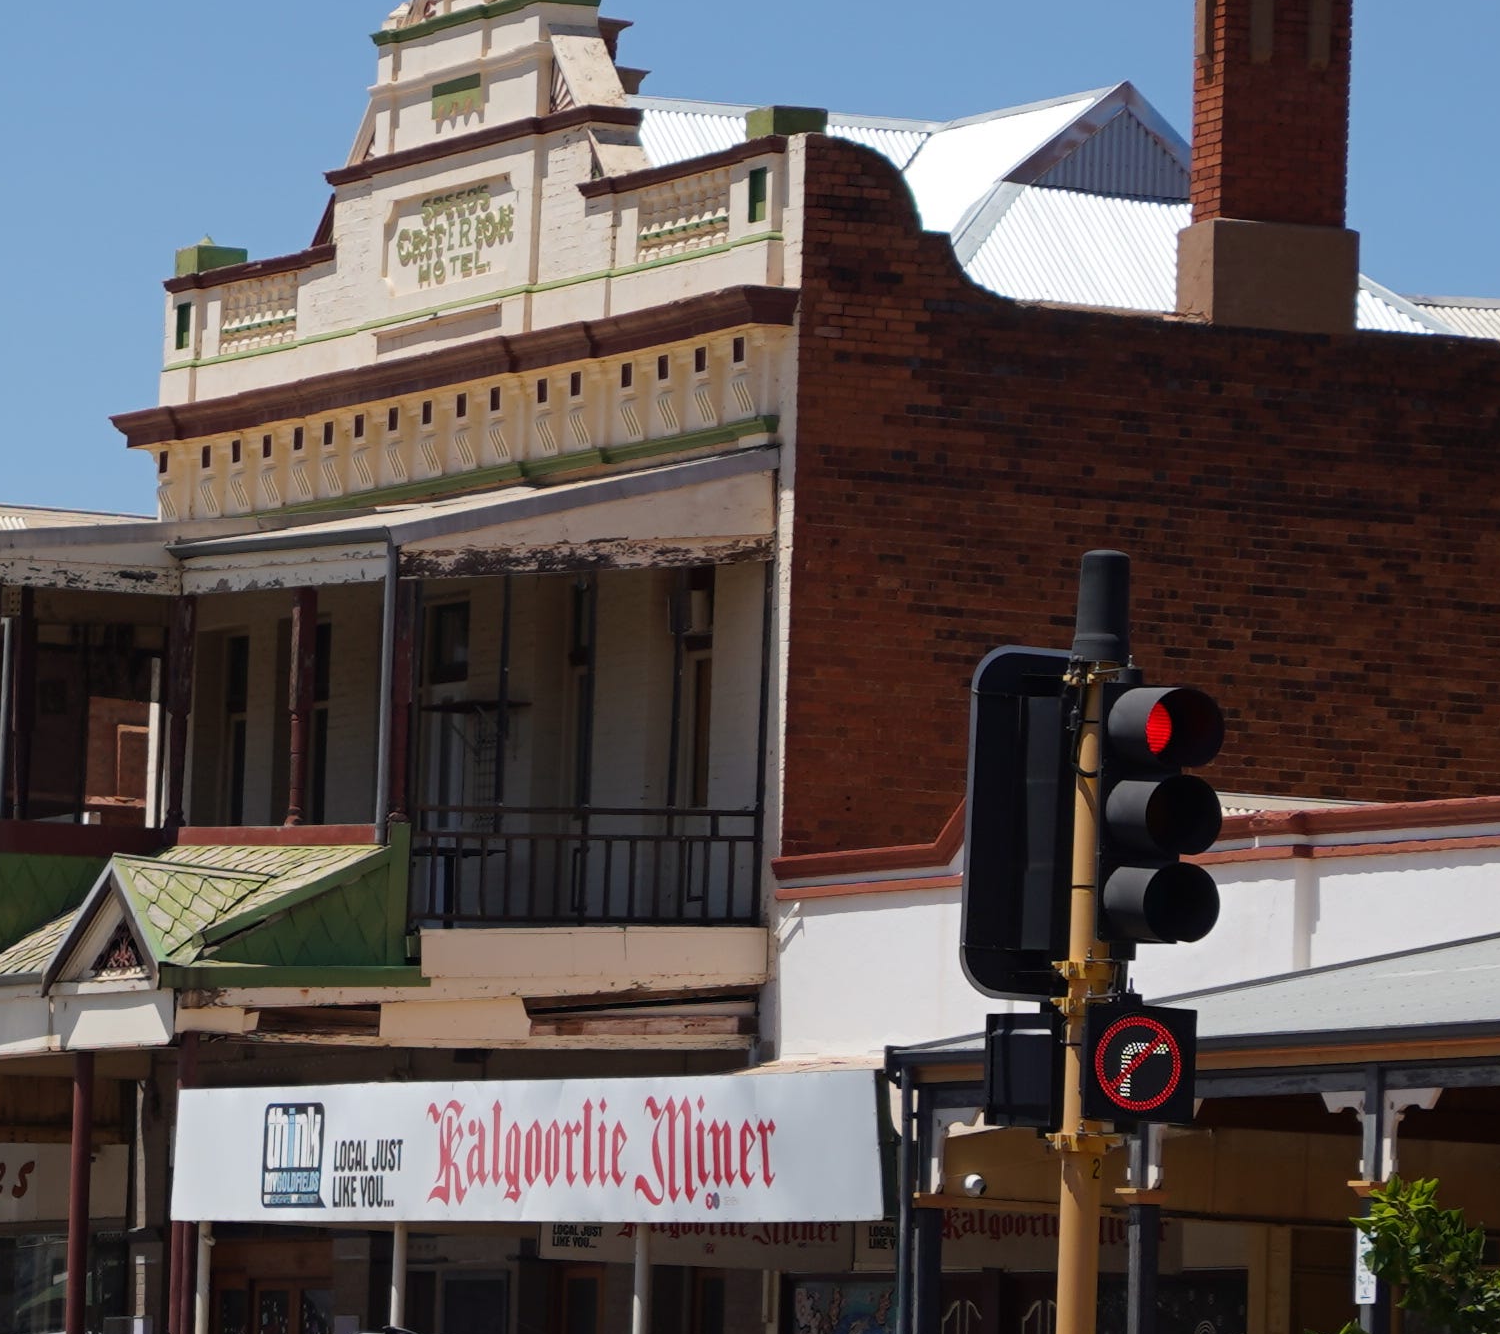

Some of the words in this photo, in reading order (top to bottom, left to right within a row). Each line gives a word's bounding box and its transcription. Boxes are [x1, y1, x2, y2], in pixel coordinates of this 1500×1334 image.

[266, 1106, 322, 1169] think
[426, 1098, 628, 1206] Kalgoorlie
[634, 1095, 776, 1206] Miner
[334, 1140, 368, 1172] LOCAL
[371, 1139, 403, 1172] JUST
[1091, 1158, 1101, 1180] 2
[332, 1175, 357, 1208] LIKE
[360, 1175, 395, 1208] YOU...
[552, 1224, 580, 1237] LOCAL
[580, 1225, 603, 1237] JUST
[941, 1207, 1060, 1241] Kalgoorli
[552, 1236, 572, 1248] LIKE
